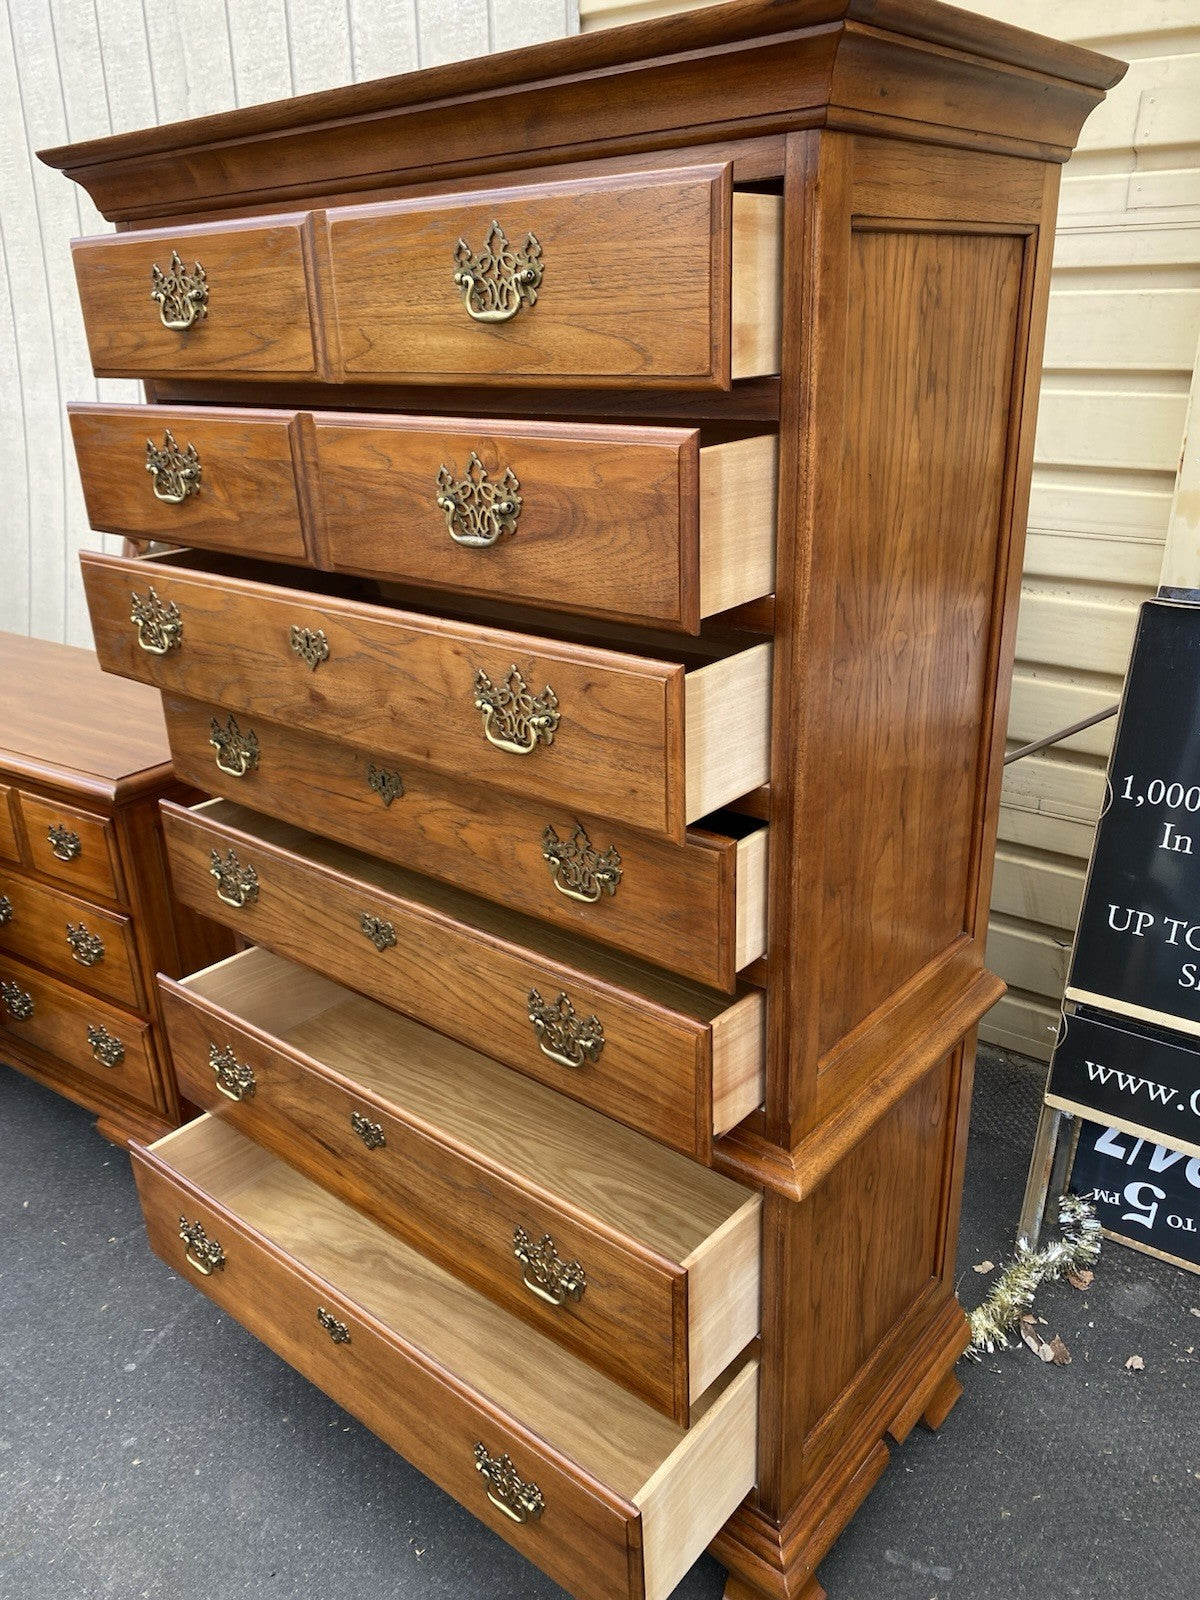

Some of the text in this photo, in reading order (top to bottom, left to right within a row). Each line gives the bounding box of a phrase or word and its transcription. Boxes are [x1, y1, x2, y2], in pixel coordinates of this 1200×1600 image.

[1158, 822, 1194, 855] In
[1108, 904, 1155, 937] UP
[1093, 1181, 1198, 1232] TO 5 PM
